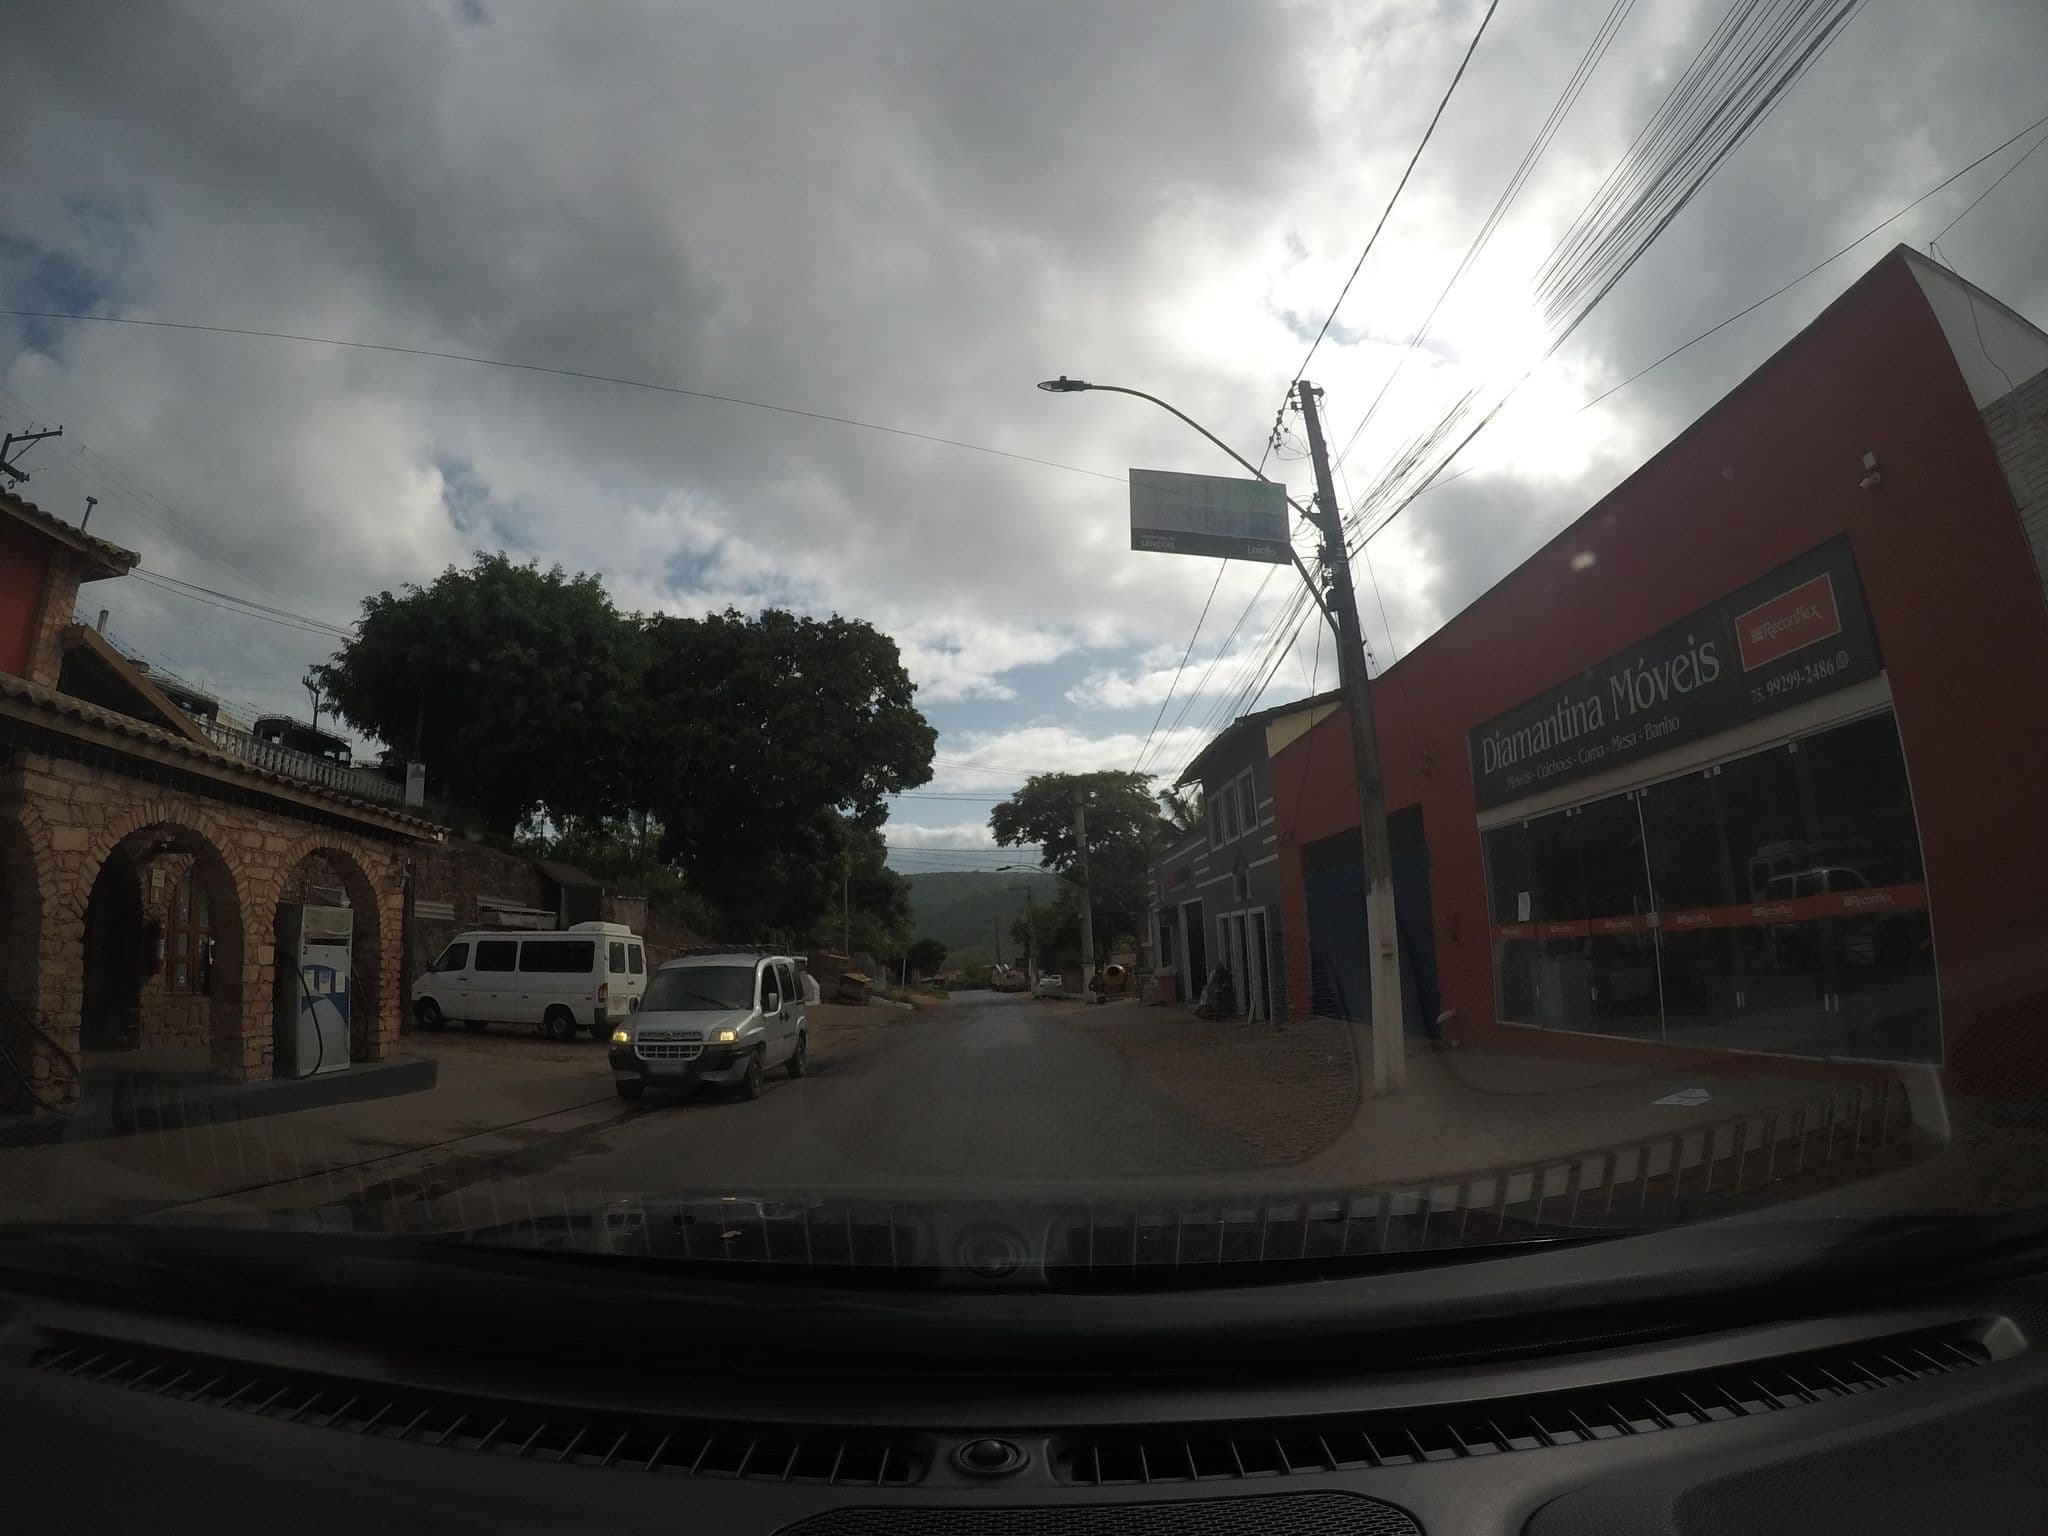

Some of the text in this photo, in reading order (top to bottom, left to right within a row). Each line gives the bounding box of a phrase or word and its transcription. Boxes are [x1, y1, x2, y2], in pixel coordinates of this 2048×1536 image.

[1482, 633, 1721, 775] Diamantina Móveis
[1611, 732, 1637, 752] Mesa
[1645, 714, 1681, 742] Banho
